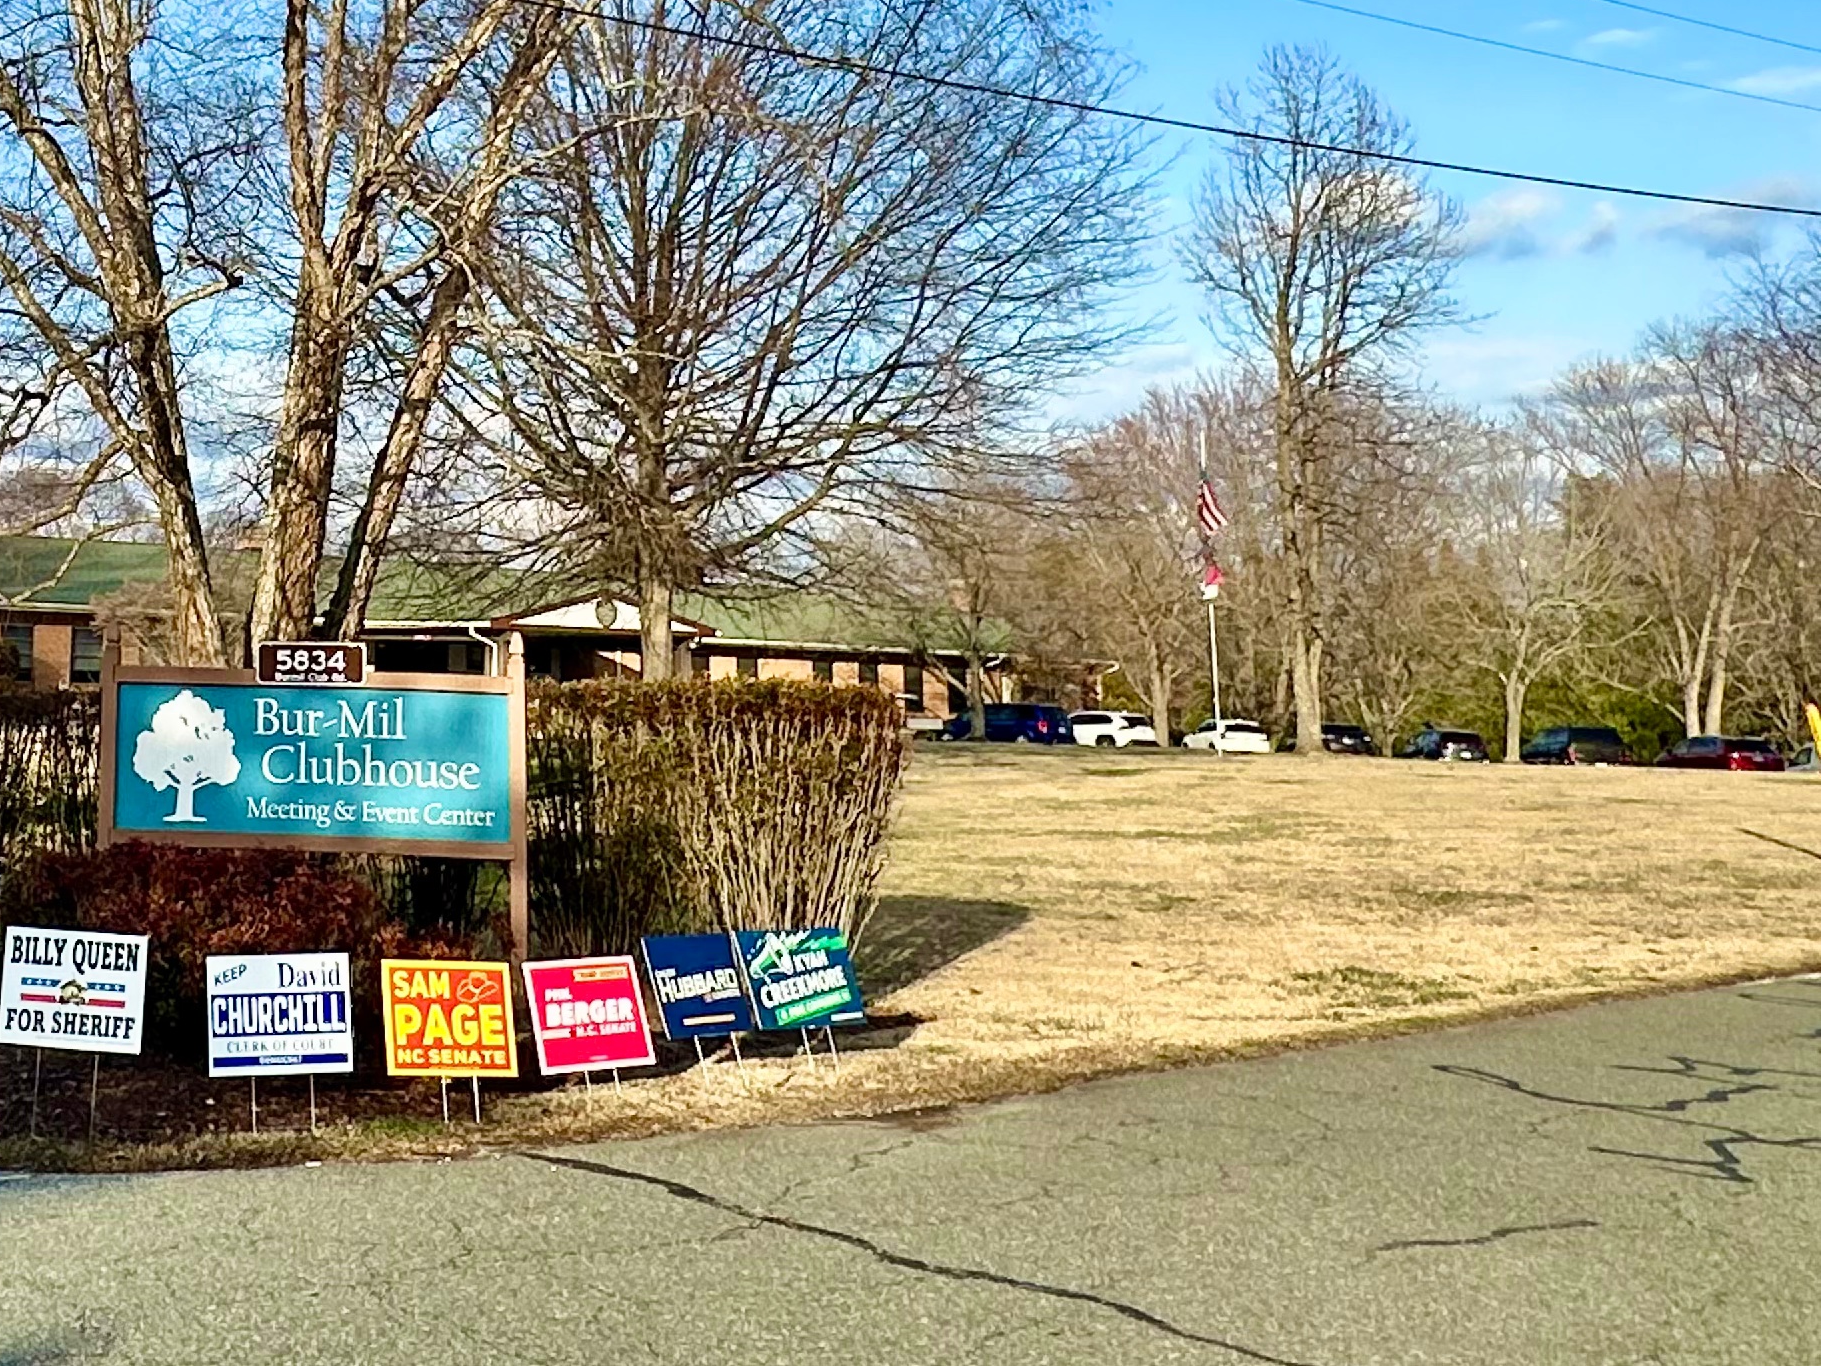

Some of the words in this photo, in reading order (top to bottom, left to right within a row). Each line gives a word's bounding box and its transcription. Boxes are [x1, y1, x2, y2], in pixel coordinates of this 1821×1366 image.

[276, 649, 346, 672] 5834
[253, 696, 407, 740] Bur-Mil
[261, 741, 480, 790] Clubhouse
[246, 796, 330, 828] Meeting
[333, 799, 356, 822] &
[361, 801, 419, 826] Event
[423, 802, 496, 827] Center
[11, 935, 67, 966] BILLY
[73, 939, 140, 975] QUEEN
[214, 963, 247, 986] KEEP
[277, 962, 341, 988] David
[393, 970, 451, 999] SAM
[656, 968, 738, 1003] HUBBARD
[760, 965, 848, 1008] CREEKMORE
[5, 1008, 45, 1033] FOR
[51, 1011, 135, 1039] SHERIFF
[212, 993, 346, 1035] CHURCHILL
[394, 1003, 505, 1046] PAGE
[545, 997, 635, 1027] BERGER
[227, 1041, 268, 1053] CLERK
[397, 1049, 424, 1064] NC
[428, 1049, 506, 1064] SENATE
